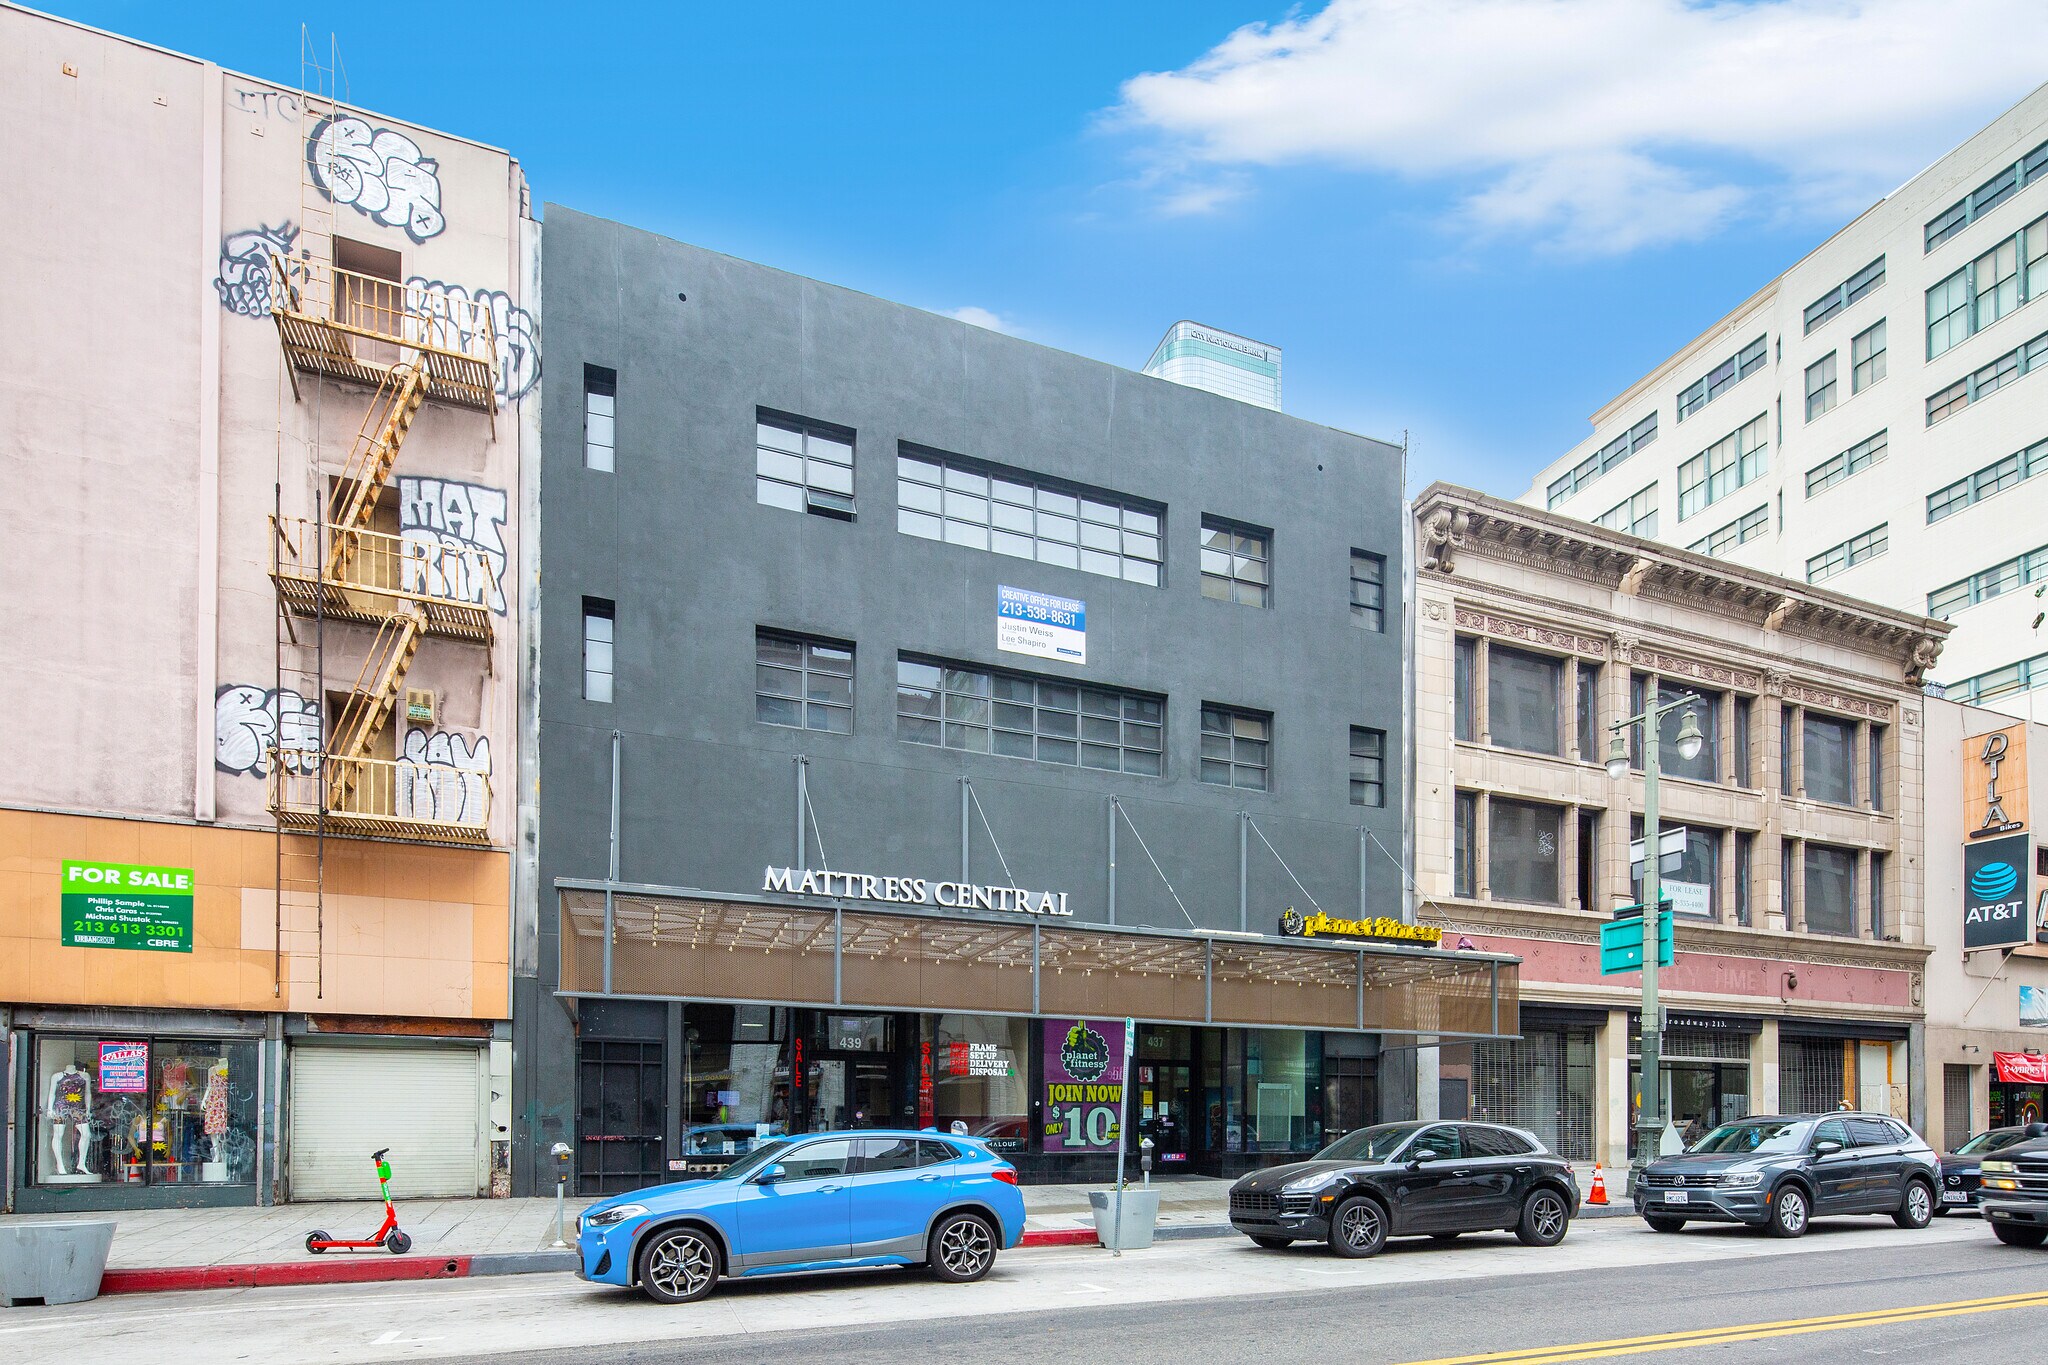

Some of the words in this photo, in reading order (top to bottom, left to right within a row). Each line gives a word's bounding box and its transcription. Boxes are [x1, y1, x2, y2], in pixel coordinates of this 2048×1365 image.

[1206, 334, 1242, 352] NATIONAL
[1242, 346, 1263, 359] BANK
[1001, 589, 1030, 603] CREATIVE
[1030, 595, 1050, 608] OFFICE
[1050, 599, 1062, 610] FOR
[1062, 601, 1080, 613] LEASE
[1001, 601, 1076, 626] 213-538-8631
[1002, 622, 1027, 633] Justin
[1029, 625, 1054, 638] Weiss
[1001, 634, 1016, 642] Lee
[1017, 636, 1047, 649] Shapiro
[1981, 733, 2010, 828] DTLA
[1999, 822, 2021, 832] Bikes
[69, 866, 121, 885] FOR
[128, 871, 189, 890] SALE
[762, 865, 927, 905] MATTRESS
[934, 880, 1074, 917] CENTRAL
[1669, 884, 1682, 893] FOR
[1684, 887, 1704, 896] LEASE
[87, 897, 114, 906] Phillip
[115, 898, 145, 908] Sample
[95, 905, 114, 913] Chris
[115, 907, 138, 915] Caras
[1965, 900, 2023, 925] AT&T
[85, 913, 117, 921] Michael
[118, 914, 151, 923] Shustak
[73, 920, 105, 933] 213
[109, 922, 141, 935] 613
[145, 924, 184, 937] 3301
[1303, 911, 1374, 937] planet
[1374, 916, 1443, 942] fitness
[146, 938, 180, 948] CBRE
[1664, 1018, 1709, 1029] roadway
[839, 1037, 862, 1049] 439
[969, 1043, 998, 1052] FRAME
[1147, 1036, 1164, 1048] 437
[106, 1050, 143, 1061] FALLAS
[969, 1052, 998, 1060] SET-UP
[1065, 1050, 1098, 1062] planet
[795, 1038, 803, 1087] SALE
[921, 1041, 931, 1089] SALE
[969, 1060, 1010, 1068] DELIVERY
[1070, 1059, 1104, 1069] fitness
[969, 1068, 1008, 1076] DISPOSAL
[1048, 1084, 1084, 1107] JOIN
[1086, 1085, 1123, 1103] NOW
[1045, 1122, 1063, 1135] ONLY
